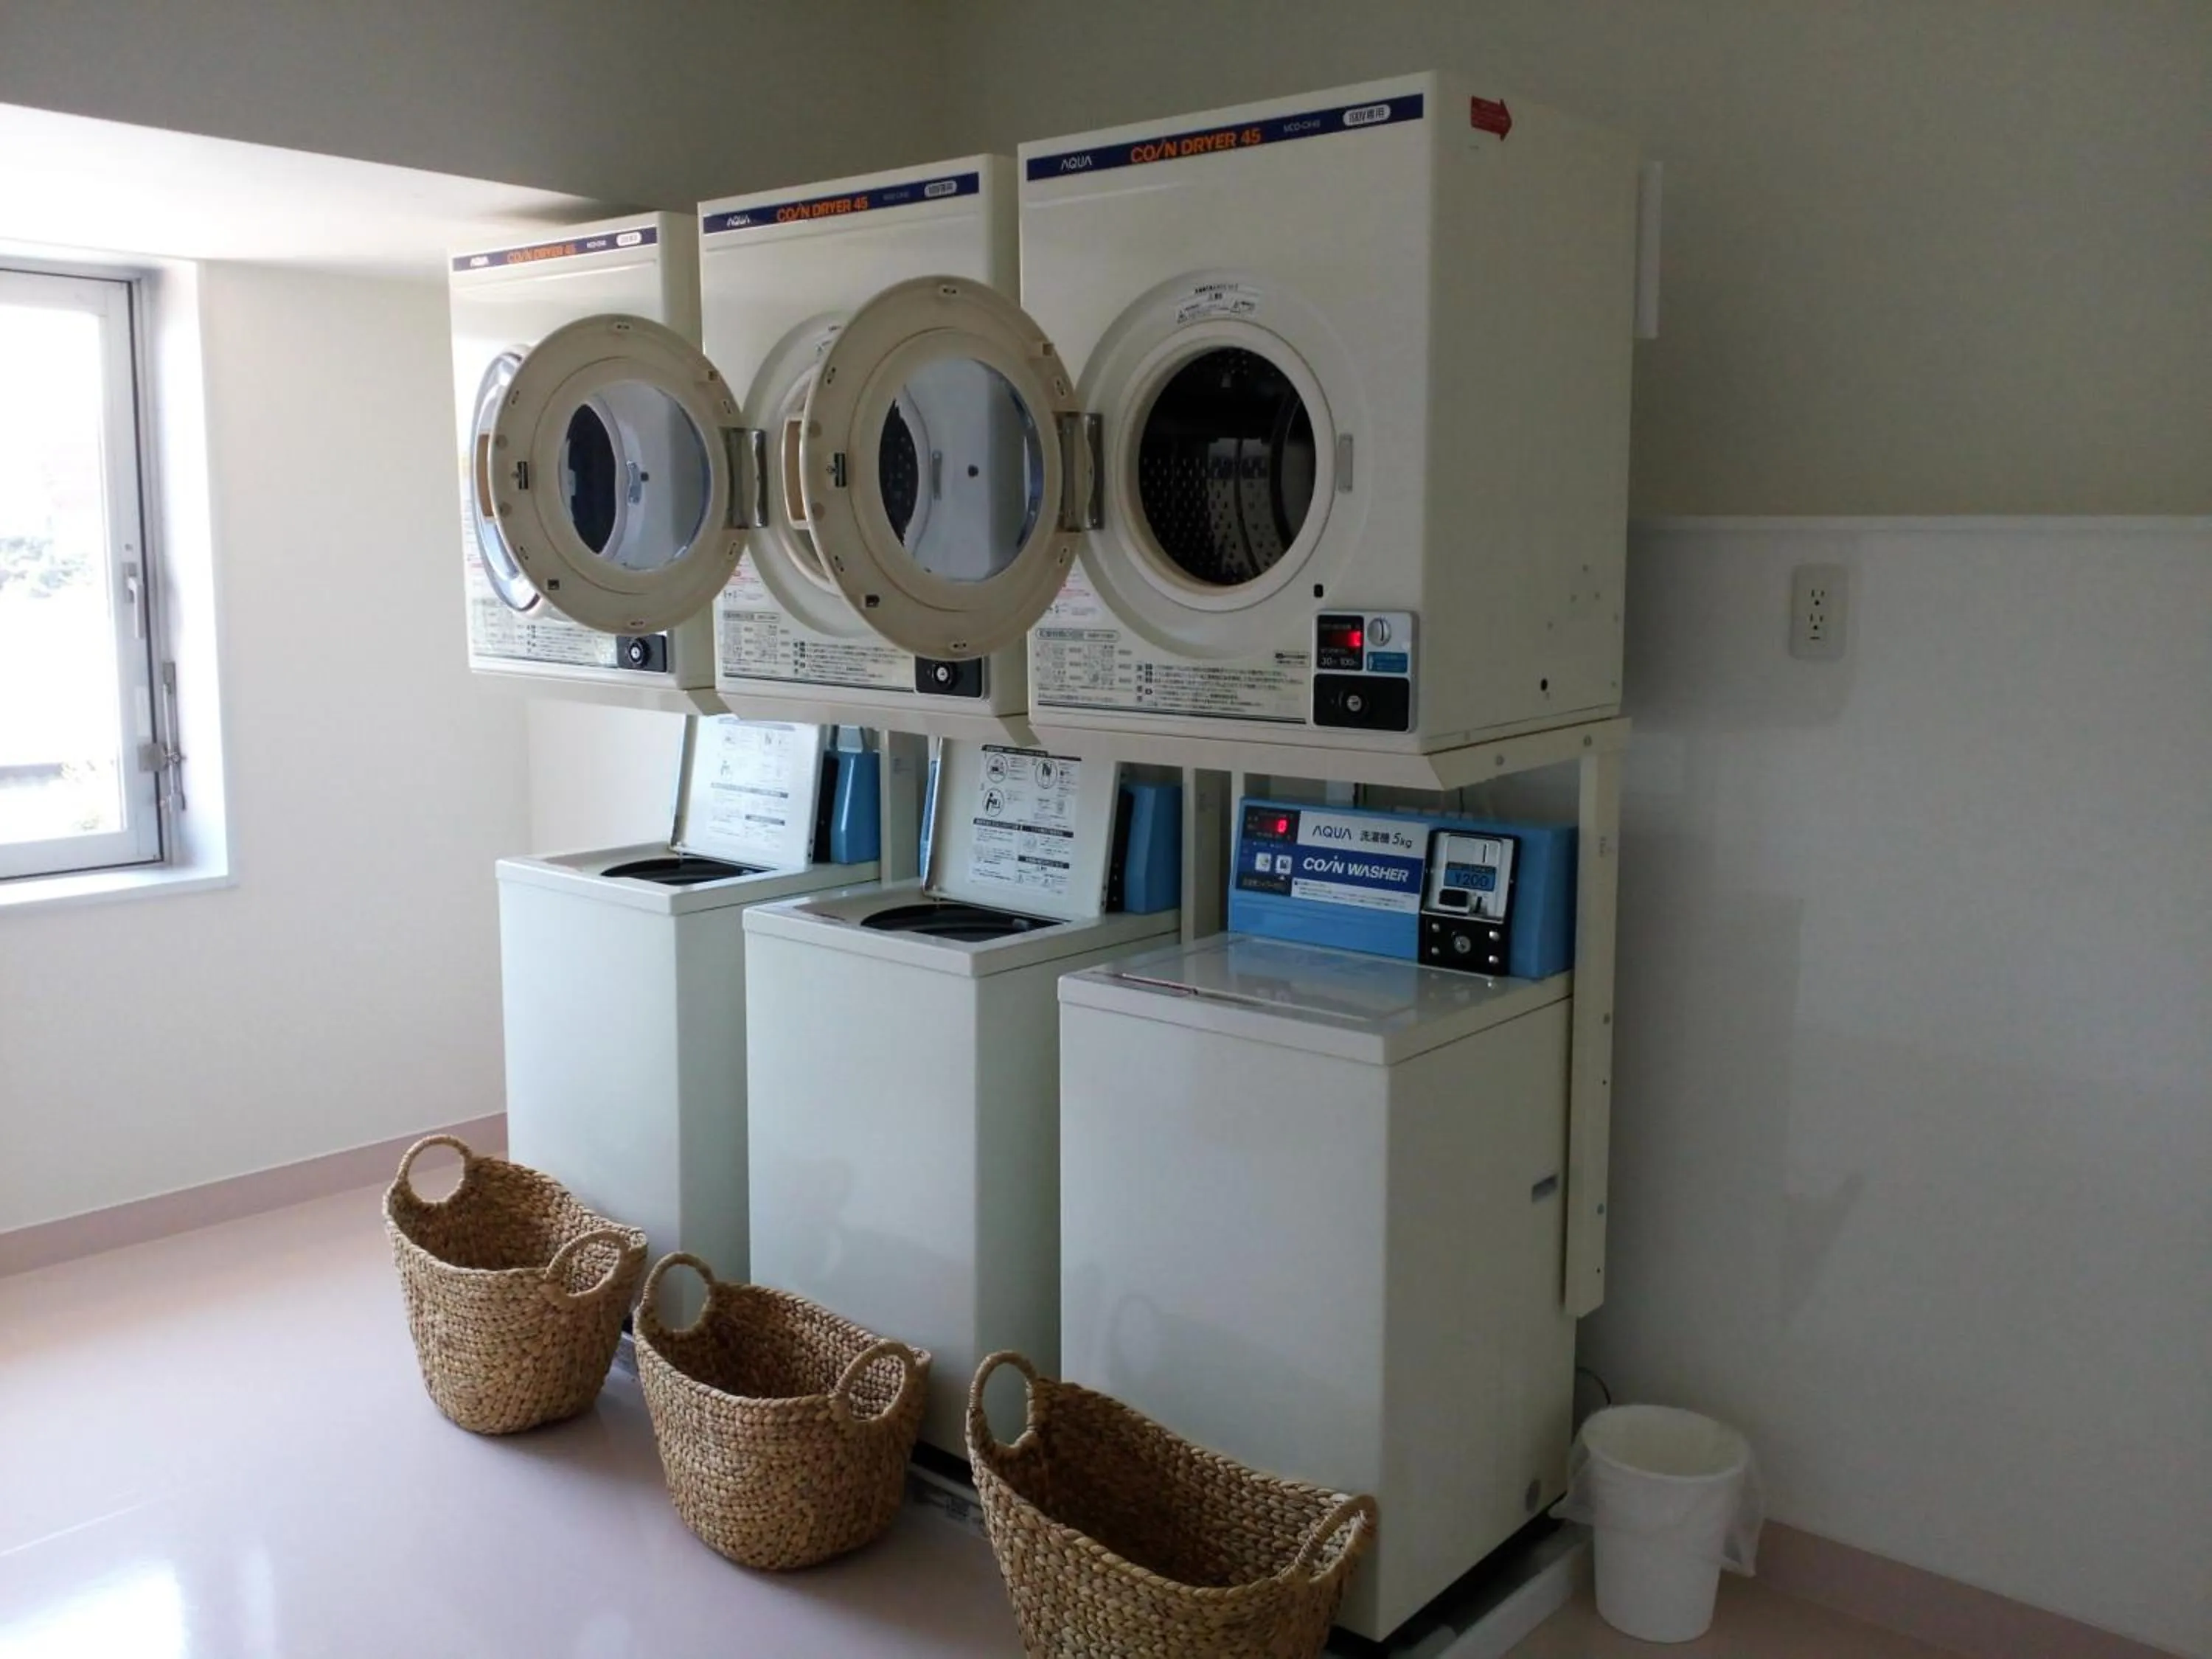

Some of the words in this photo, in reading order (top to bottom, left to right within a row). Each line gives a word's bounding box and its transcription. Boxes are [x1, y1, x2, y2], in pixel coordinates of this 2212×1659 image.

[1061, 154, 1092, 171] AQUA
[1181, 131, 1237, 154] DRYER
[1242, 128, 1262, 146] 45
[813, 199, 851, 218] DRYER
[853, 195, 869, 211] 45
[1312, 824, 1352, 841] AQUA
[1391, 832, 1413, 848] 5kg
[1303, 855, 1344, 875] COIN
[1347, 861, 1409, 883] WASHER
